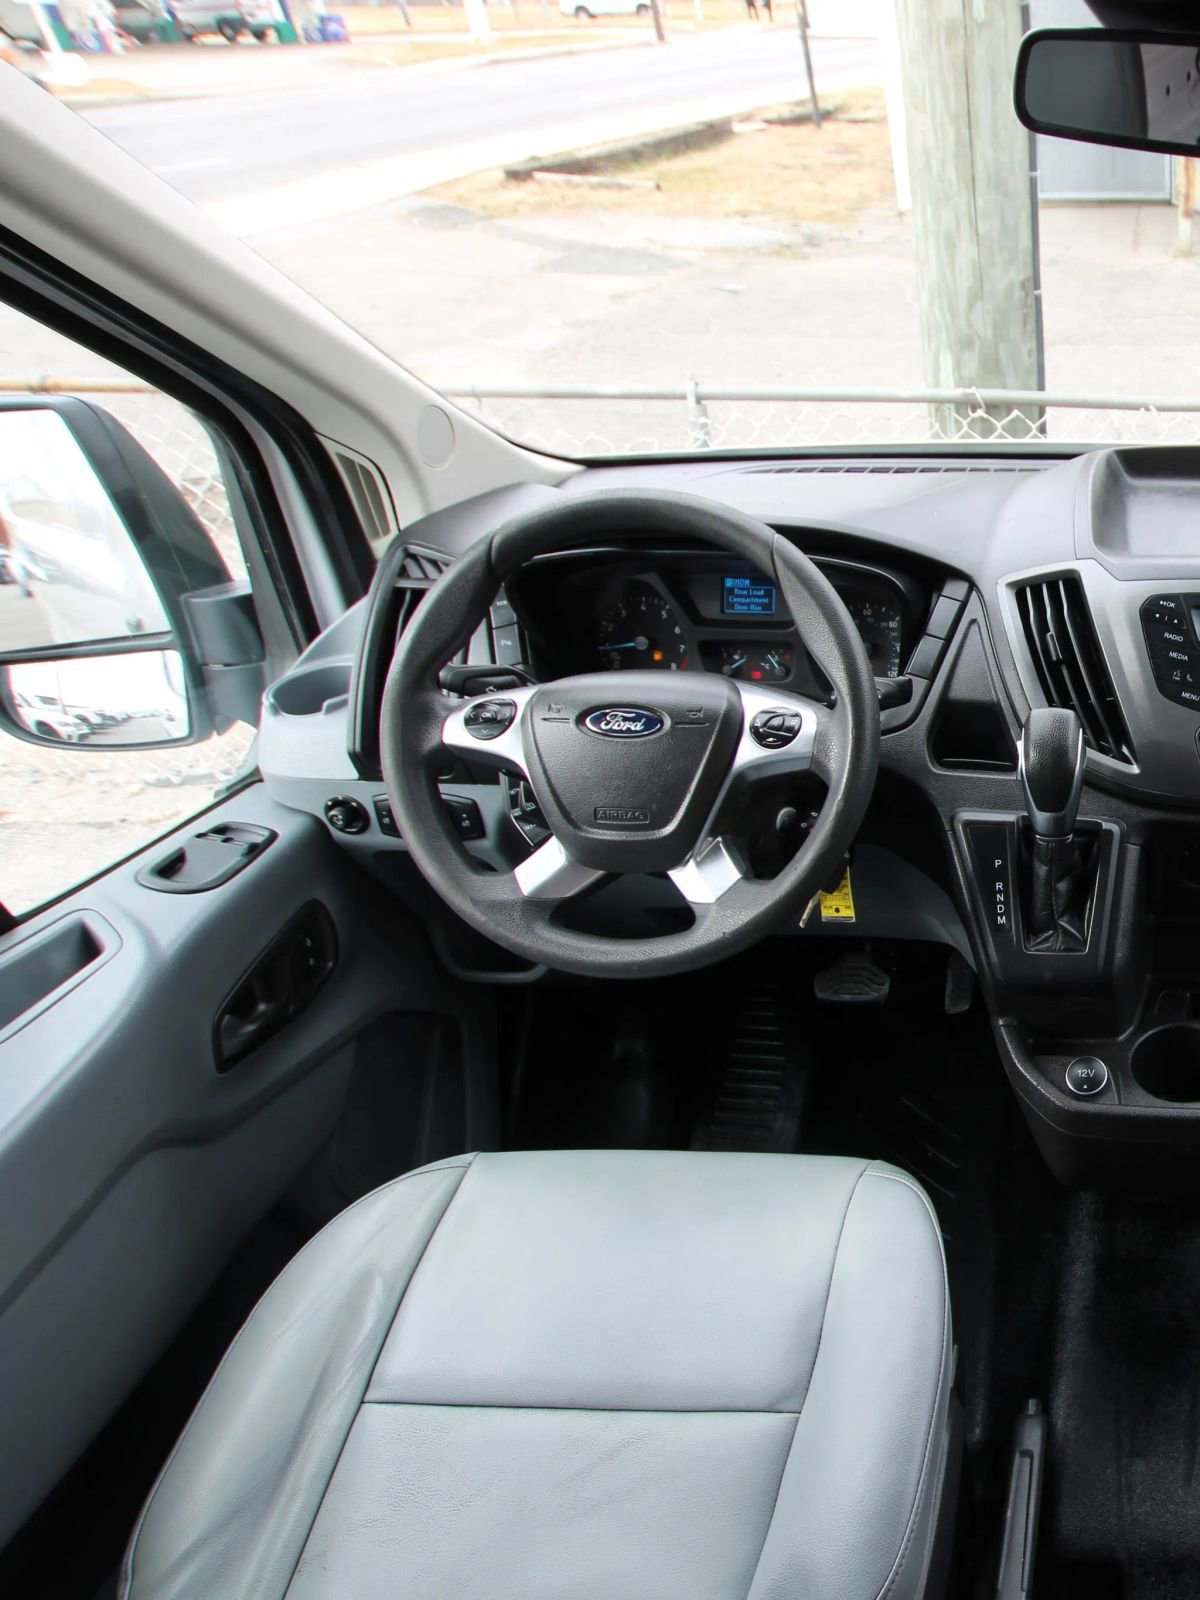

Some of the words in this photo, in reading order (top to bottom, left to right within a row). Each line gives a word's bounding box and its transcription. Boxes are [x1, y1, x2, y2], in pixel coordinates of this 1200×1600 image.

[661, 610, 667, 619] 5
[674, 625, 681, 634] 6
[1164, 632, 1184, 642] RADIO
[679, 644, 685, 653] 7
[1169, 651, 1189, 661] MEDIA
[670, 662, 677, 671] 8
[1181, 691, 1200, 701] MENU
[601, 711, 646, 731] Ford
[598, 811, 646, 820] AIRBAG
[994, 859, 1002, 868] P
[995, 882, 1004, 891] R
[996, 893, 1004, 902] N
[997, 904, 1005, 913] D
[997, 915, 1006, 925] M
[1077, 1069, 1095, 1078] 12V
